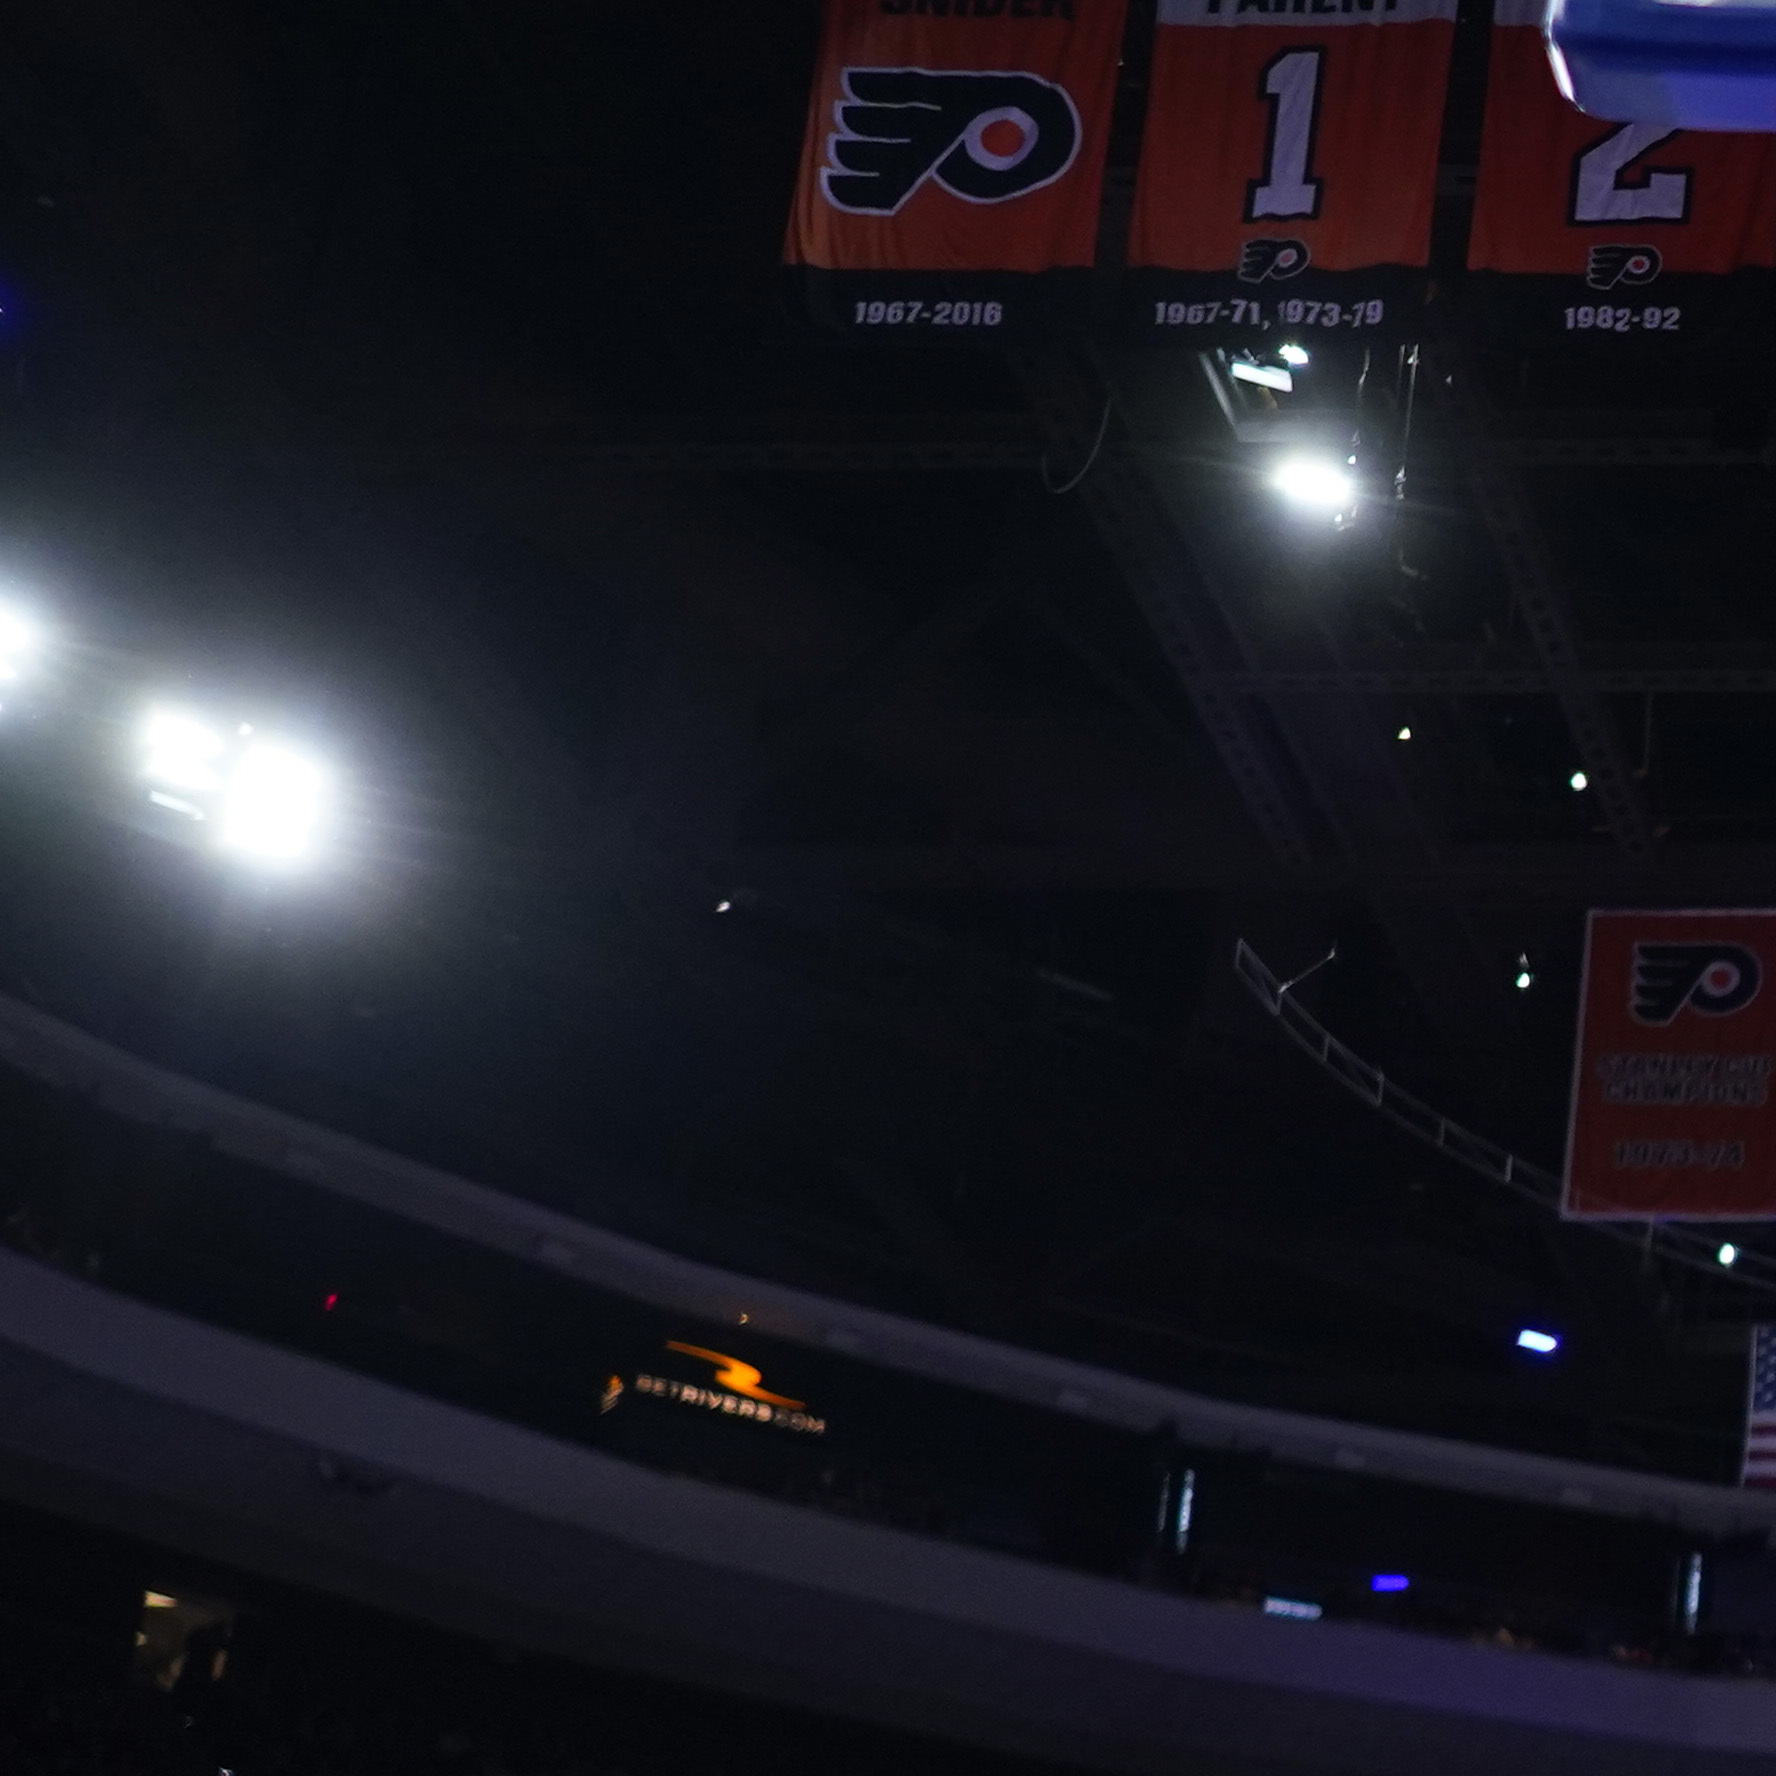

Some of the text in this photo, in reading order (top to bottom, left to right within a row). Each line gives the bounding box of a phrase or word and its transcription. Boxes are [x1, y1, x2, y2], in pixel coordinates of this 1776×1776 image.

[1243, 46, 1326, 222] 1
[854, 301, 1002, 326] 1967-2016
[1564, 305, 1681, 331] 1982-92
